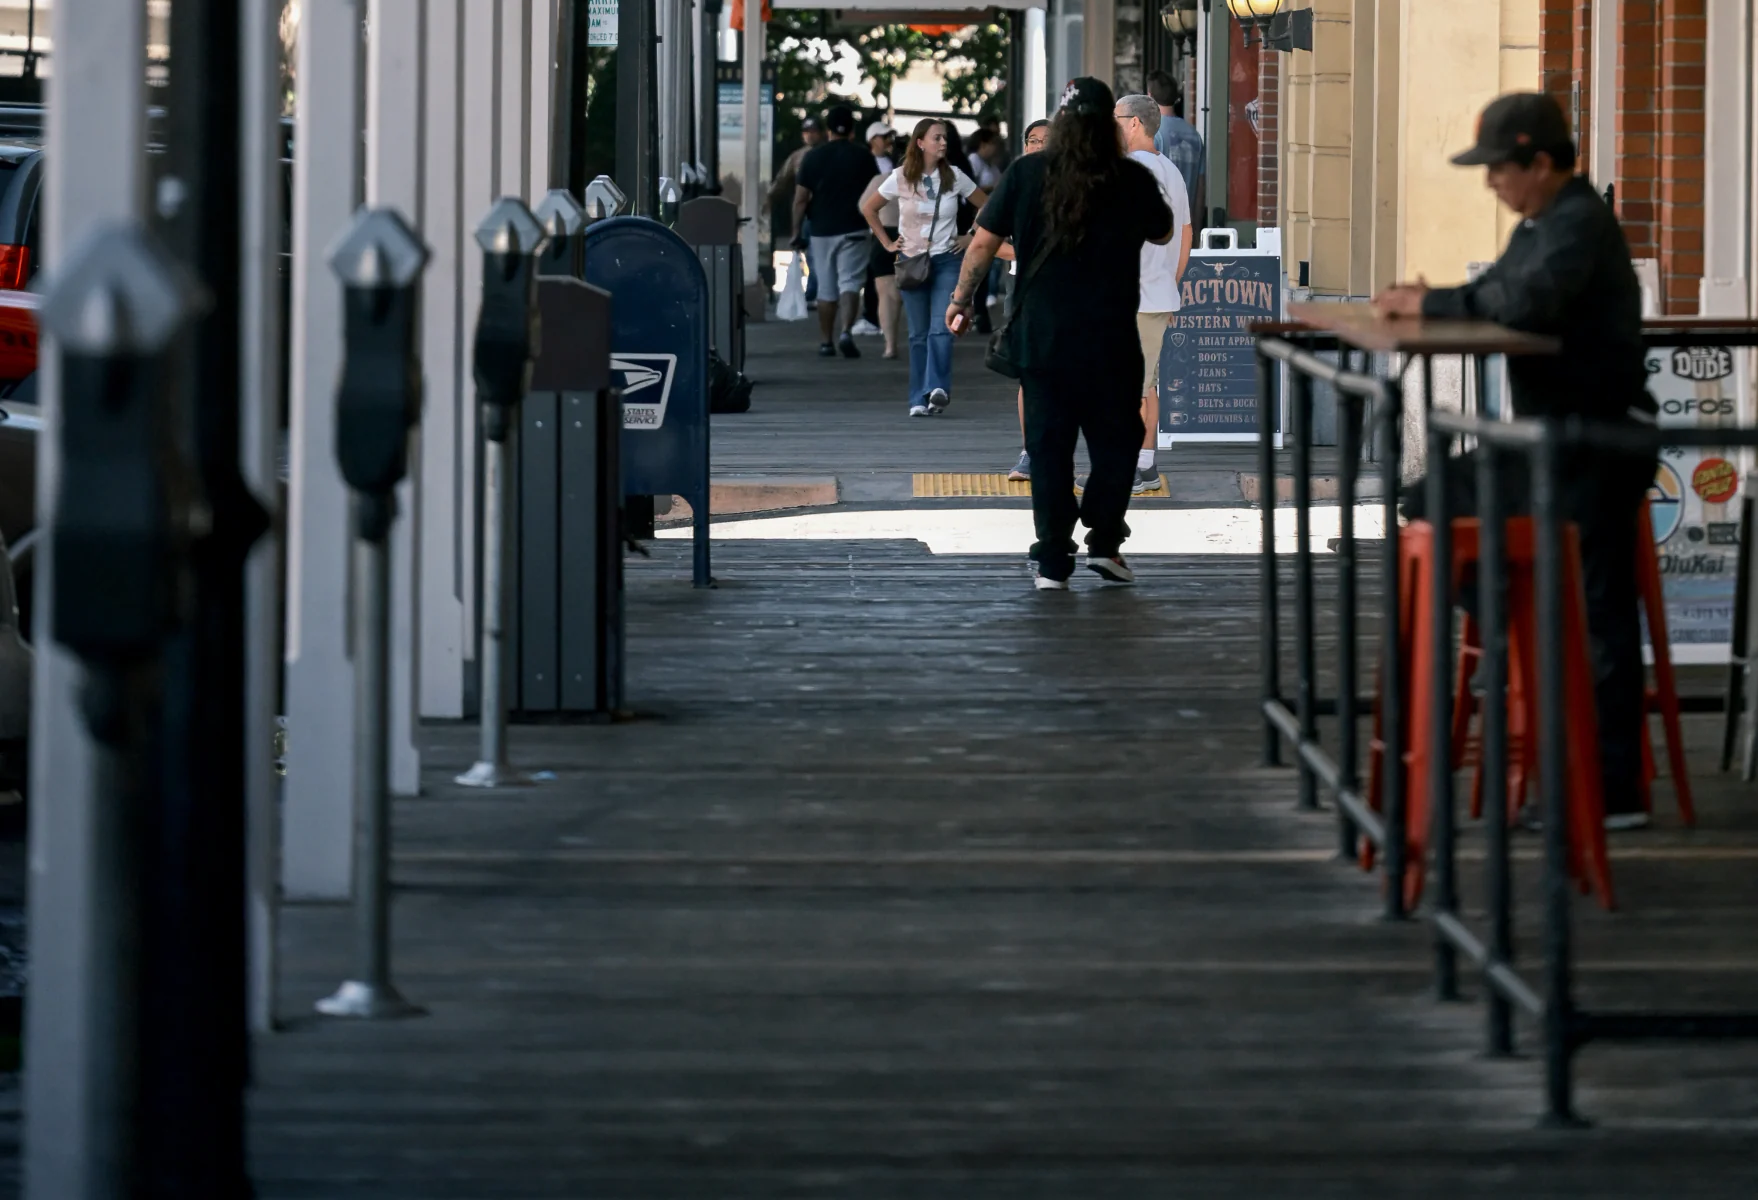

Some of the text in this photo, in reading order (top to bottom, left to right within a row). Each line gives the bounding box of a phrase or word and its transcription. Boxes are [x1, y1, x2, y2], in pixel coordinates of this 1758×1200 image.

[1180, 278, 1273, 312] ACTOWN
[1167, 315, 1231, 328] WESTERN
[1198, 336, 1256, 346] ARIAT APPAR
[1198, 352, 1228, 362] BOOTS
[1673, 351, 1731, 379] DUDE
[1198, 368, 1227, 377] JEANS
[1198, 383, 1222, 392] HATS
[1198, 399, 1224, 408] BELTS
[1661, 399, 1734, 416] OFOS
[1198, 414, 1243, 424] SOUVENIRS
